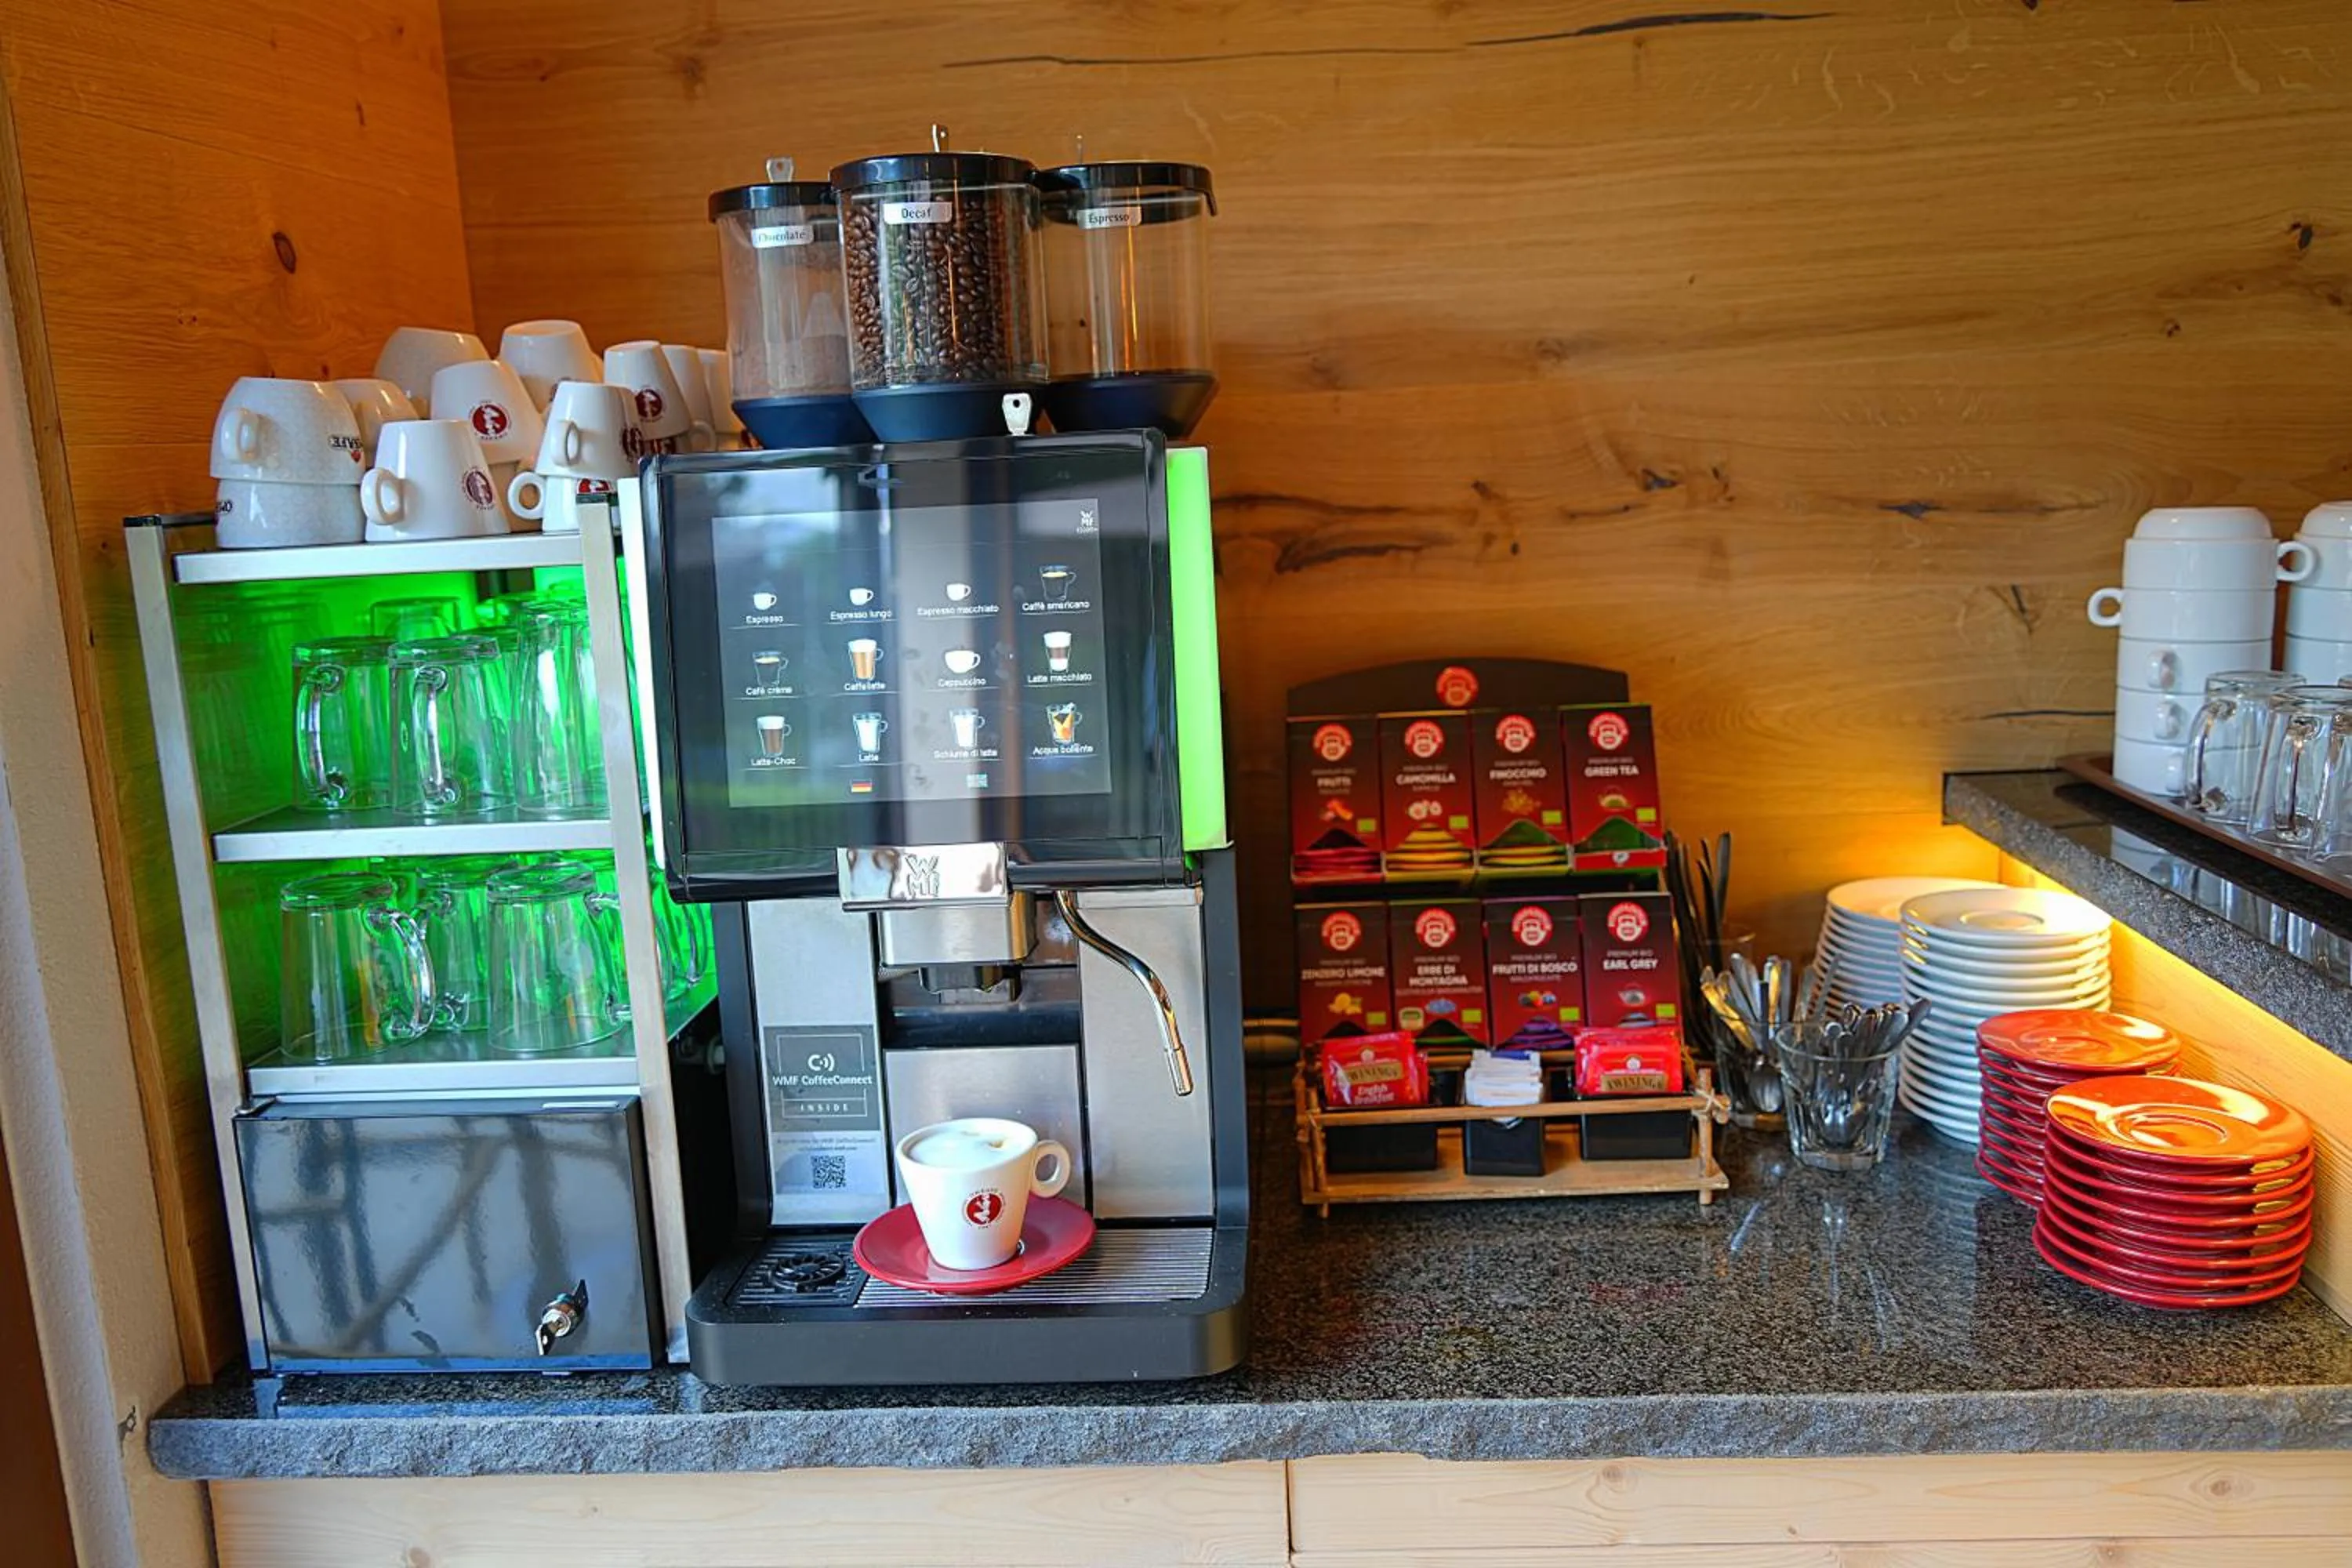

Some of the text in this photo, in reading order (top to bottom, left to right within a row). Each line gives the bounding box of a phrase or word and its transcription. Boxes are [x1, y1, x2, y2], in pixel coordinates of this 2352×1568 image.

[902, 208, 931, 219] Decaf
[1088, 212, 1131, 225] Espresso
[830, 609, 892, 621] Espresso lungo
[917, 604, 1000, 616] Espresso macchiato
[746, 615, 783, 625] Espresso
[938, 677, 986, 688] Cappuccino
[1027, 673, 1091, 684] Latte macchiato
[858, 753, 879, 762] Latte
[1490, 768, 1547, 780] FINOCCHIO
[1584, 765, 1639, 778] GREEN TEA
[1317, 776, 1352, 786] FRUTTI
[1396, 773, 1456, 785] CAMOMILLA
[1417, 964, 1456, 975] ERBE DI
[1492, 962, 1577, 975] FRUTTI DI BOSCO
[1603, 958, 1658, 971] EARL GREY
[1346, 967, 1385, 978] LIMONE
[1409, 975, 1468, 986] MONTAGNA
[772, 1075, 873, 1086] WMF CoffeeConnect
[800, 1103, 848, 1112] INSIDE
